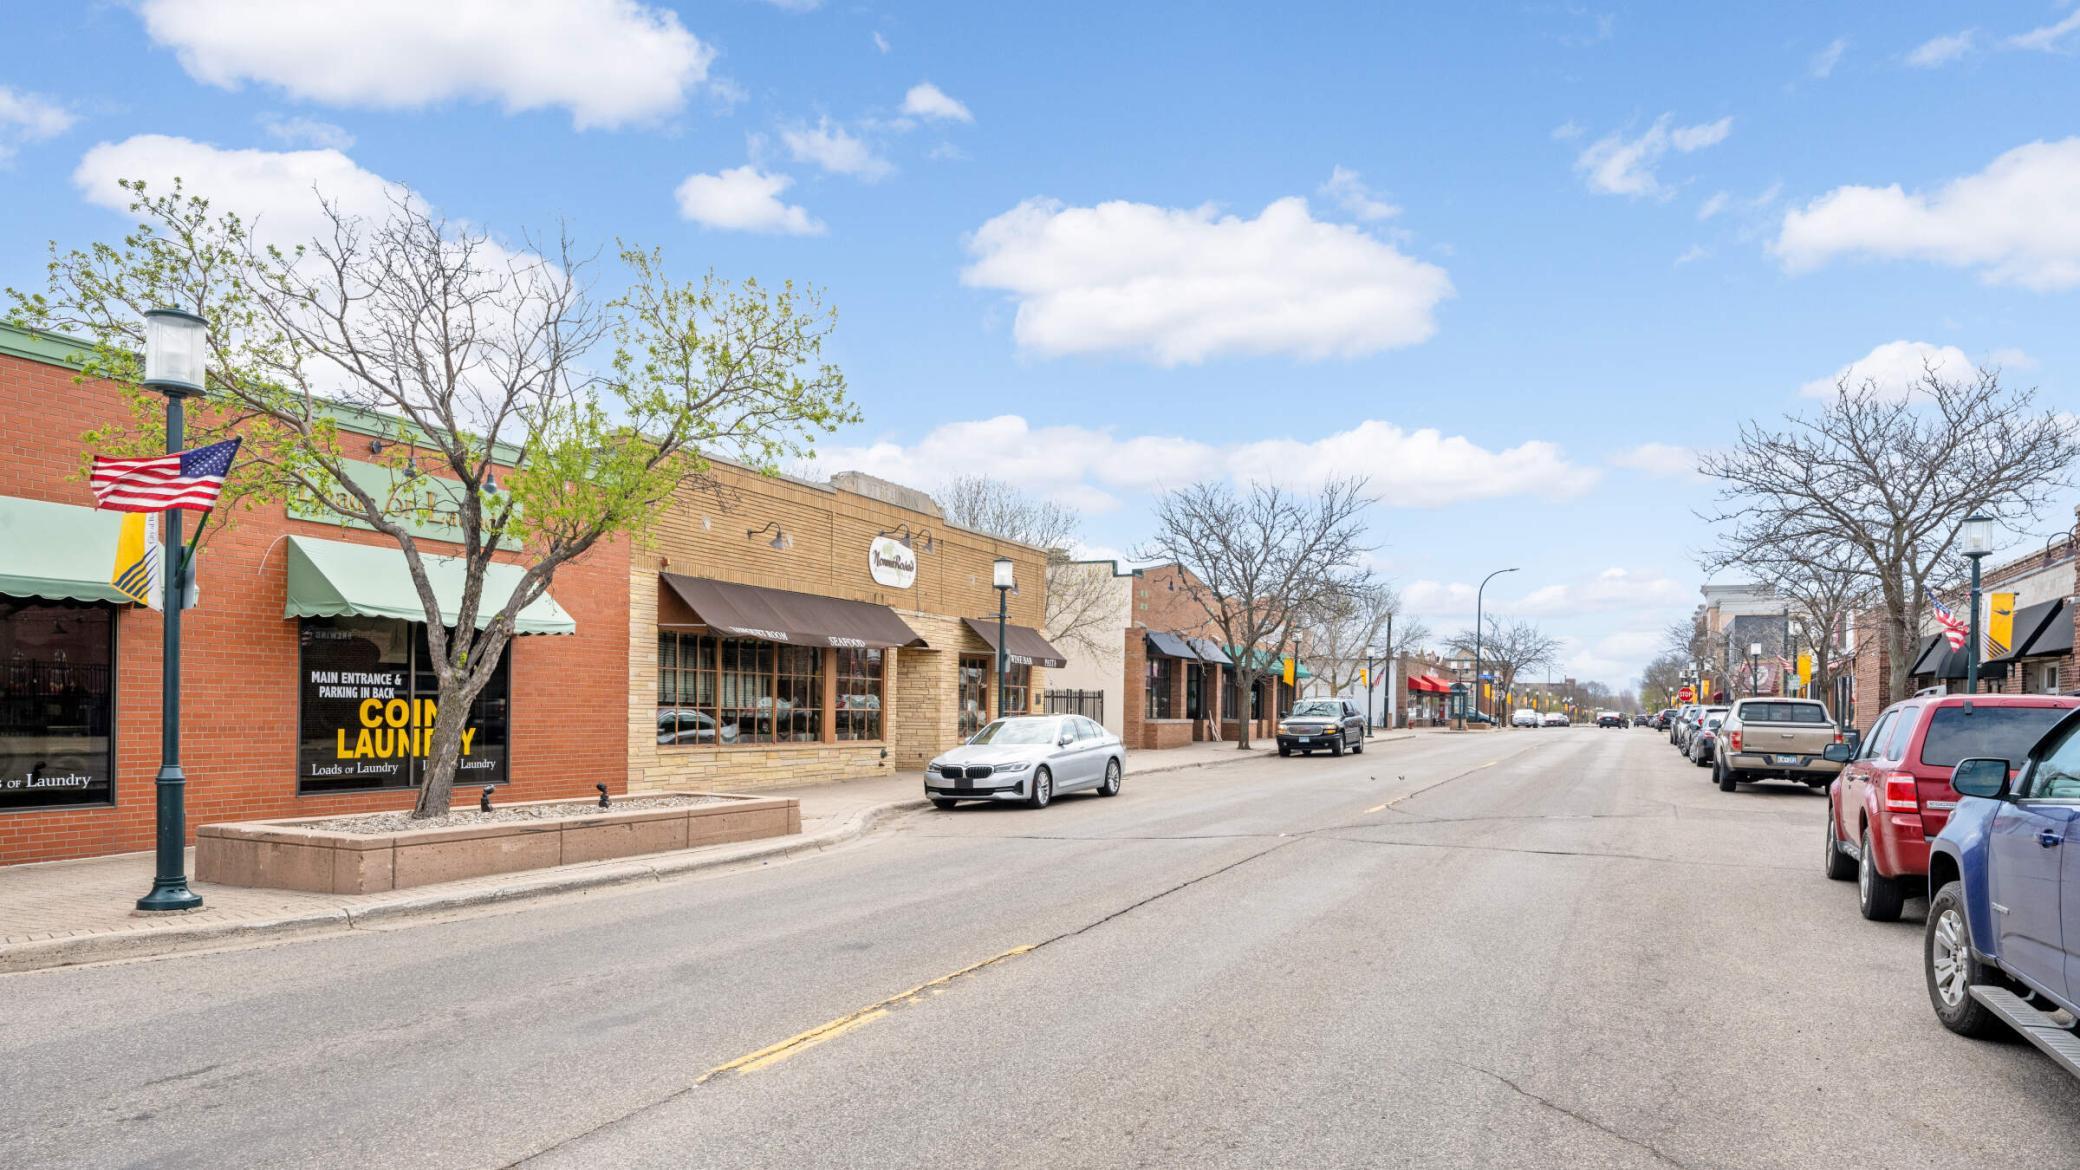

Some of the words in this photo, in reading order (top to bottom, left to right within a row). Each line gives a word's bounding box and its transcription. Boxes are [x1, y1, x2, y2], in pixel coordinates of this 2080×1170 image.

[828, 636, 866, 648] SEAFOOD
[311, 671, 338, 684] MAIN
[341, 672, 392, 686] ENTRANCE
[394, 674, 402, 686] &
[319, 686, 358, 698] PARKING
[360, 687, 370, 699] IN
[372, 687, 395, 699] BACK
[1680, 690, 1692, 698] STOP
[311, 763, 342, 776] Loads
[357, 761, 399, 775] Laundry
[460, 759, 497, 771] Laundry
[25, 773, 92, 789] Laundry
